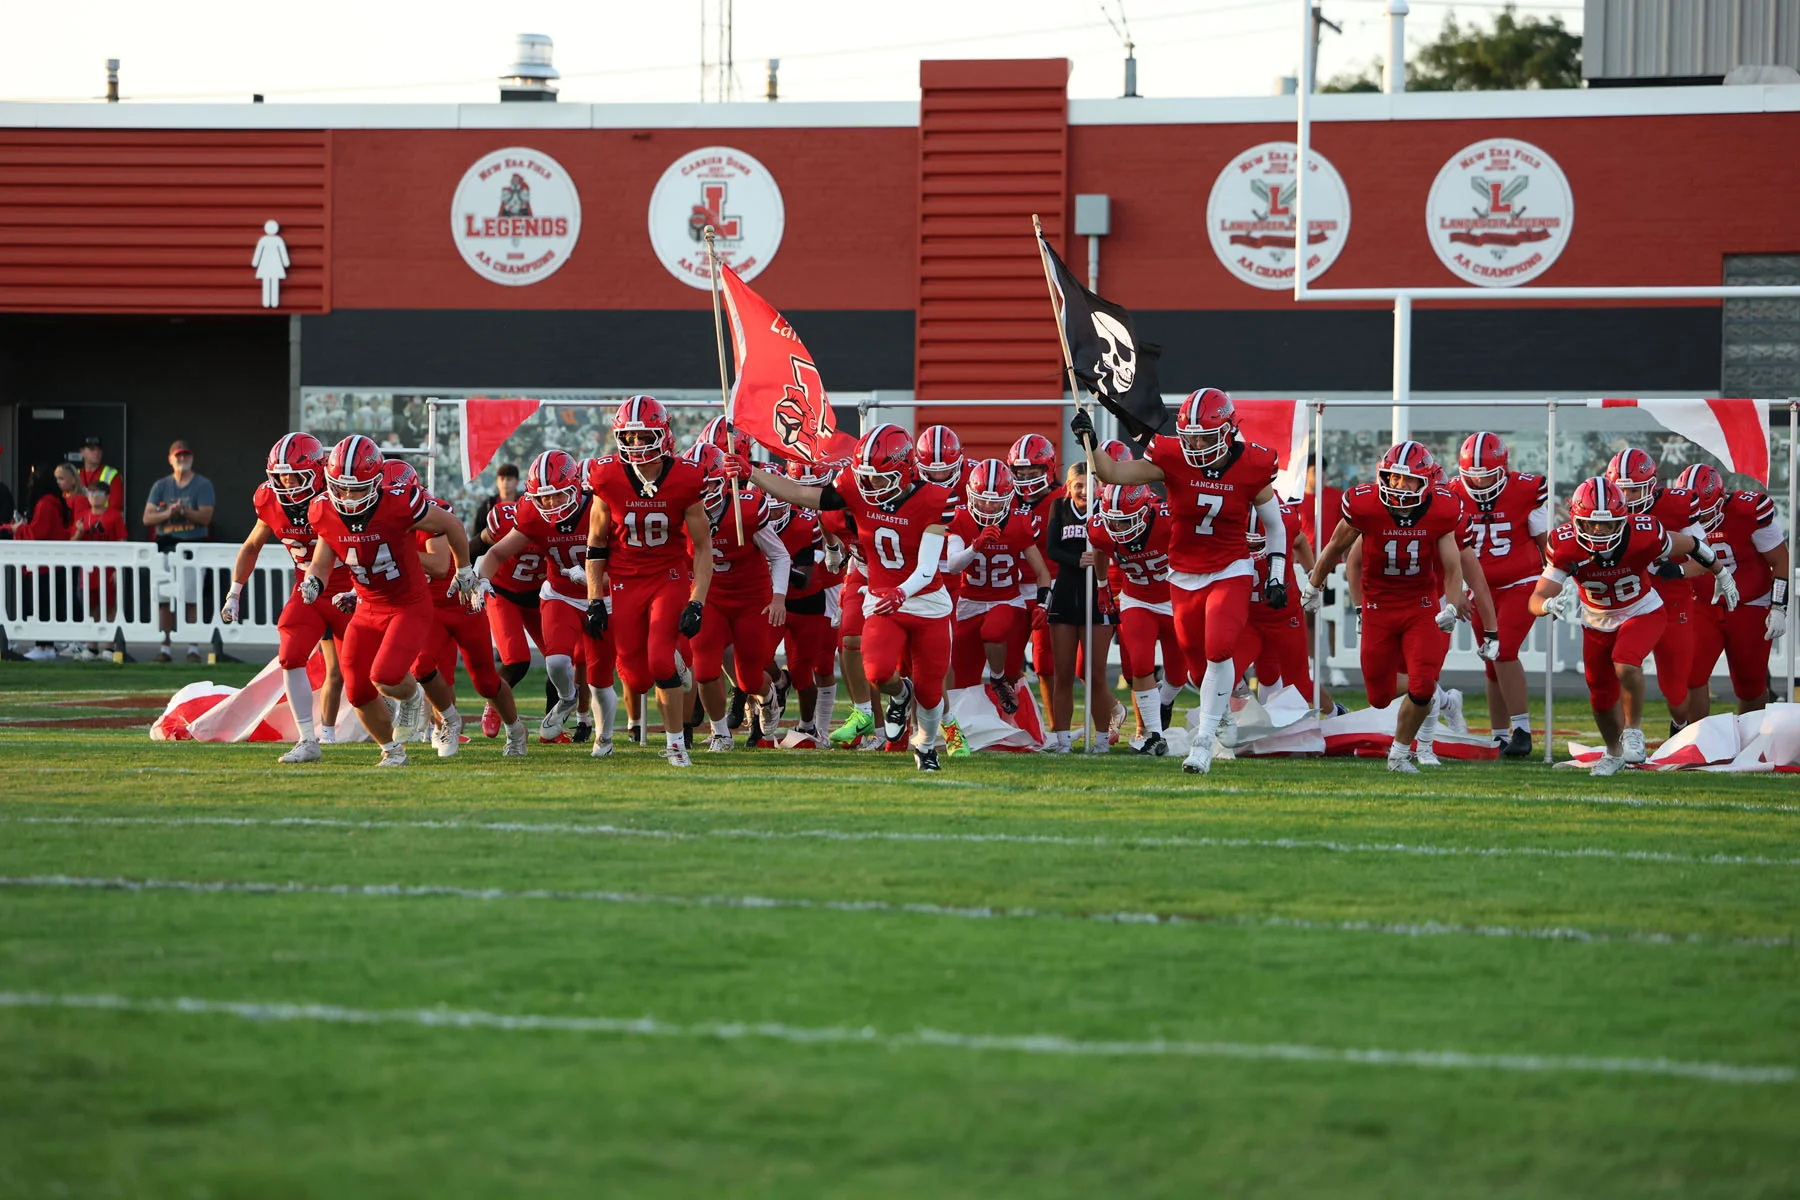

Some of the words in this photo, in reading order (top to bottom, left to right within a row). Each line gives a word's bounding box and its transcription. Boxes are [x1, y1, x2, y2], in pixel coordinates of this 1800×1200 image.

[1268, 186, 1290, 215] L
[1489, 182, 1512, 213] L
[465, 213, 568, 238] LEGENDS
[1190, 479, 1234, 491] LANCASTER
[625, 501, 667, 509] LANCASTER
[866, 511, 909, 526] LANCASTER
[1194, 493, 1224, 535] 7
[338, 533, 380, 543] LANCASTER
[547, 535, 587, 543] LANCASTER
[623, 511, 670, 548] 18
[1383, 529, 1427, 537] LANCASTER
[1472, 522, 1512, 558] 75
[874, 526, 905, 570] 0
[1384, 539, 1421, 577] 11
[344, 543, 401, 586] 44
[967, 552, 1014, 588] 32
[1119, 553, 1170, 586] 25
[1580, 574, 1642, 606] 28
